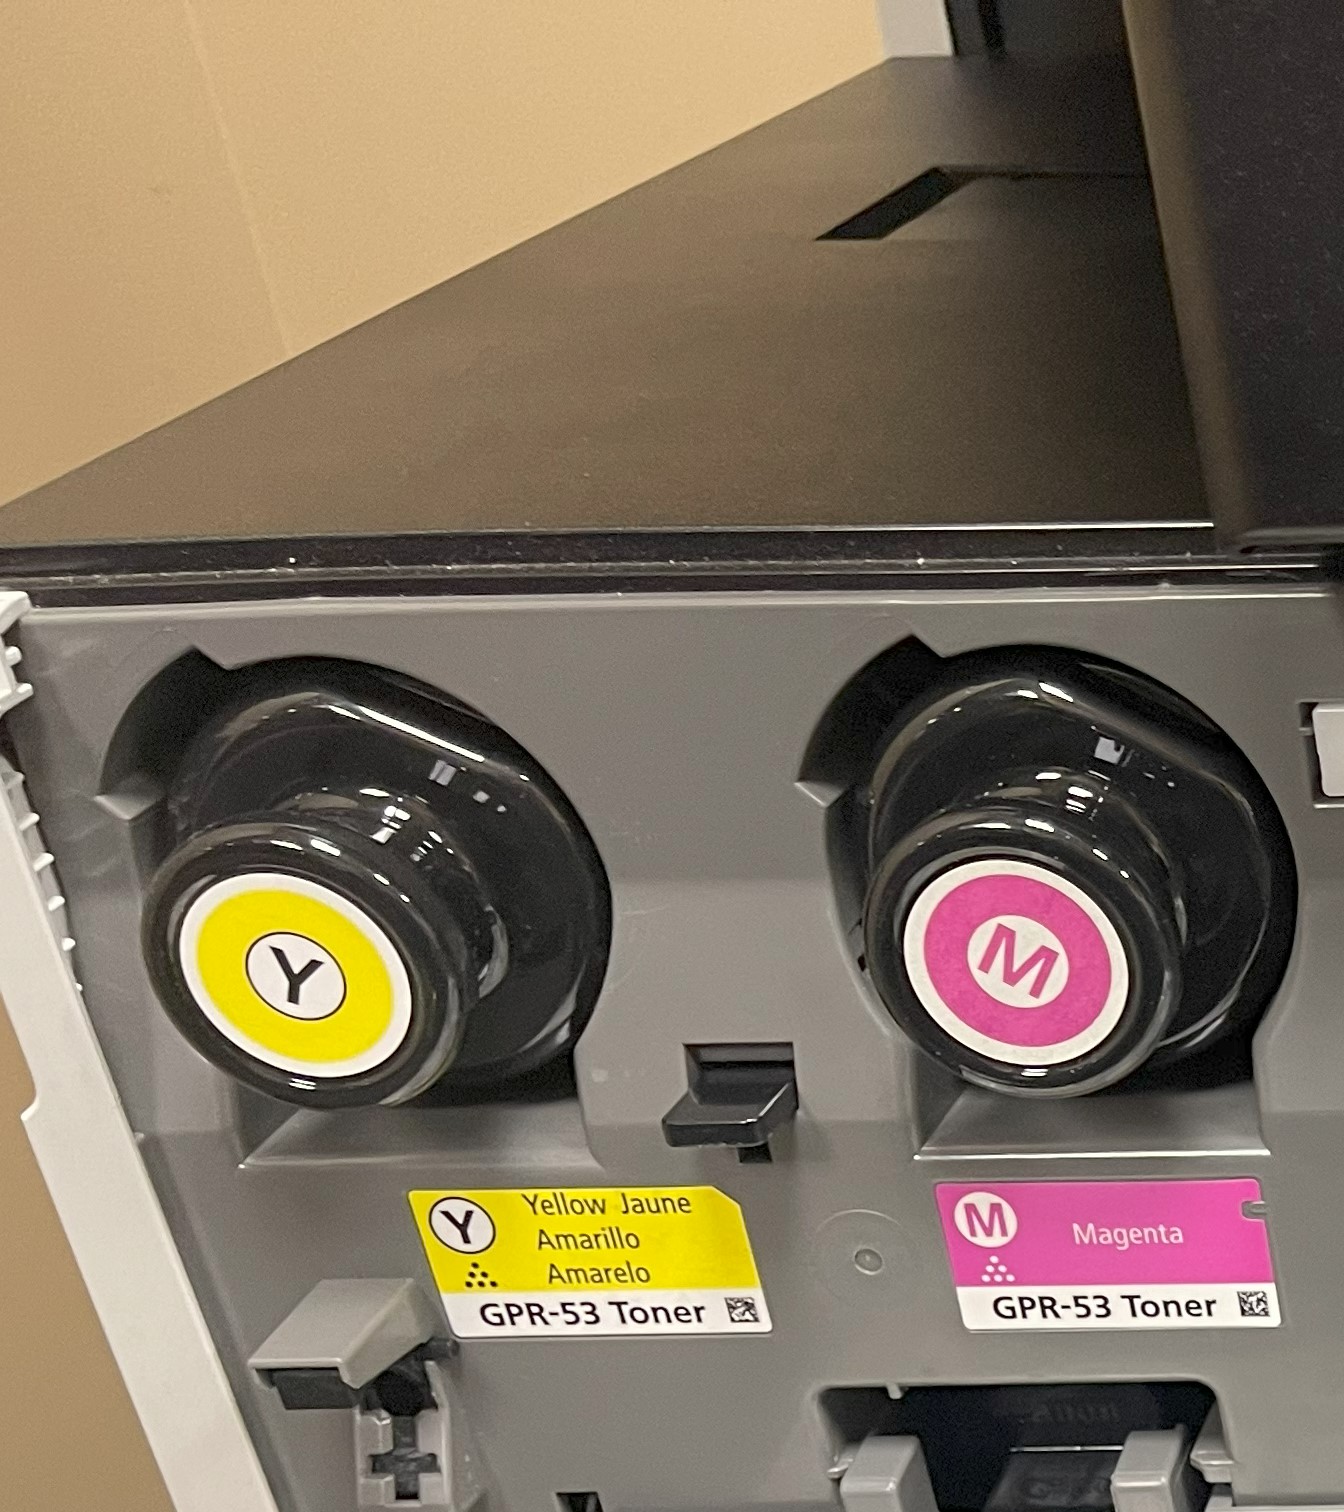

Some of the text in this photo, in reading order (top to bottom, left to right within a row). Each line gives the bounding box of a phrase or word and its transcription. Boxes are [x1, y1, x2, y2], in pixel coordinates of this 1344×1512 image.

[978, 923, 1059, 999] M
[267, 946, 322, 1005] Y
[522, 1192, 692, 1216] Yellow Jaune
[440, 1210, 475, 1244] Y
[963, 1202, 1009, 1238] M
[538, 1226, 640, 1250] Amarillo
[1071, 1222, 1185, 1251] Magenta
[548, 1260, 650, 1285] Amarelo
[480, 1301, 705, 1326] GPR-53 Toner
[992, 1294, 1217, 1319] GPR-53 Toner
